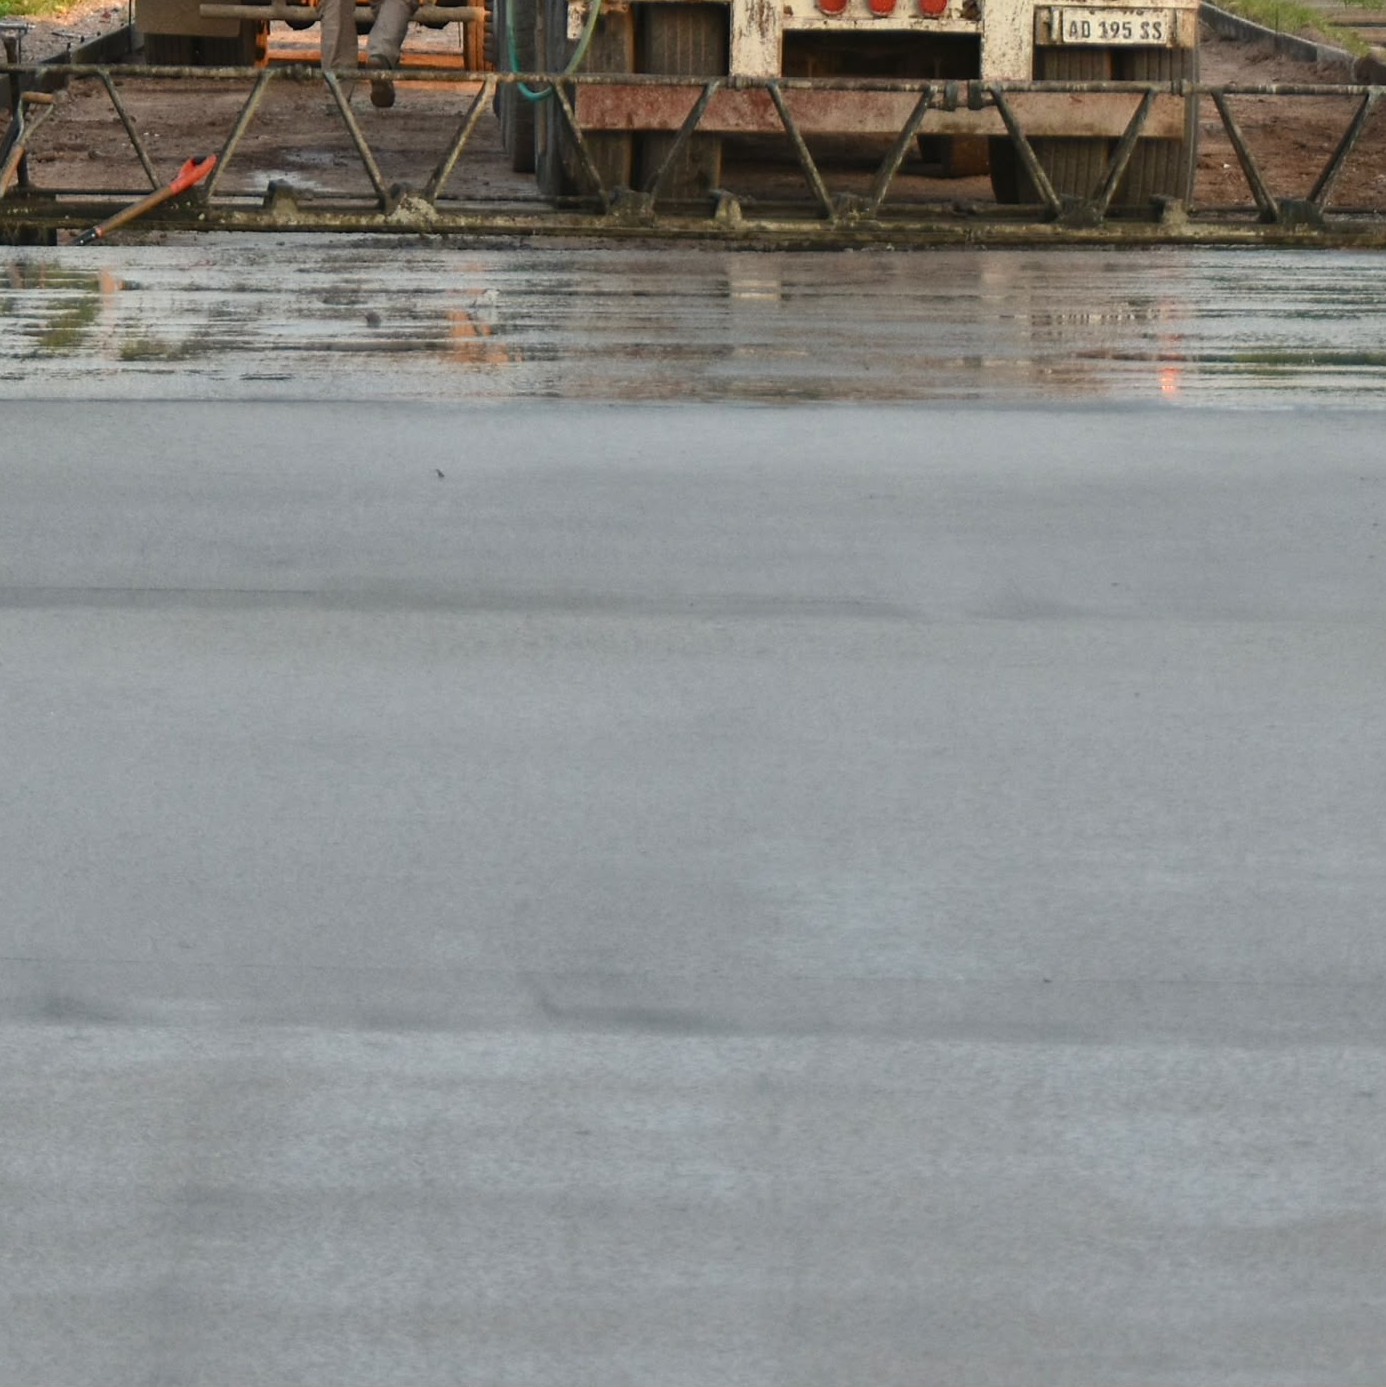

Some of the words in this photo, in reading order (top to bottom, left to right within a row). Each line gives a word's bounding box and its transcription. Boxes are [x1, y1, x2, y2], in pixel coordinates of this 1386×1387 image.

[1069, 20, 1091, 38] AD
[1098, 21, 1132, 39] 195
[1140, 21, 1162, 40] SS
